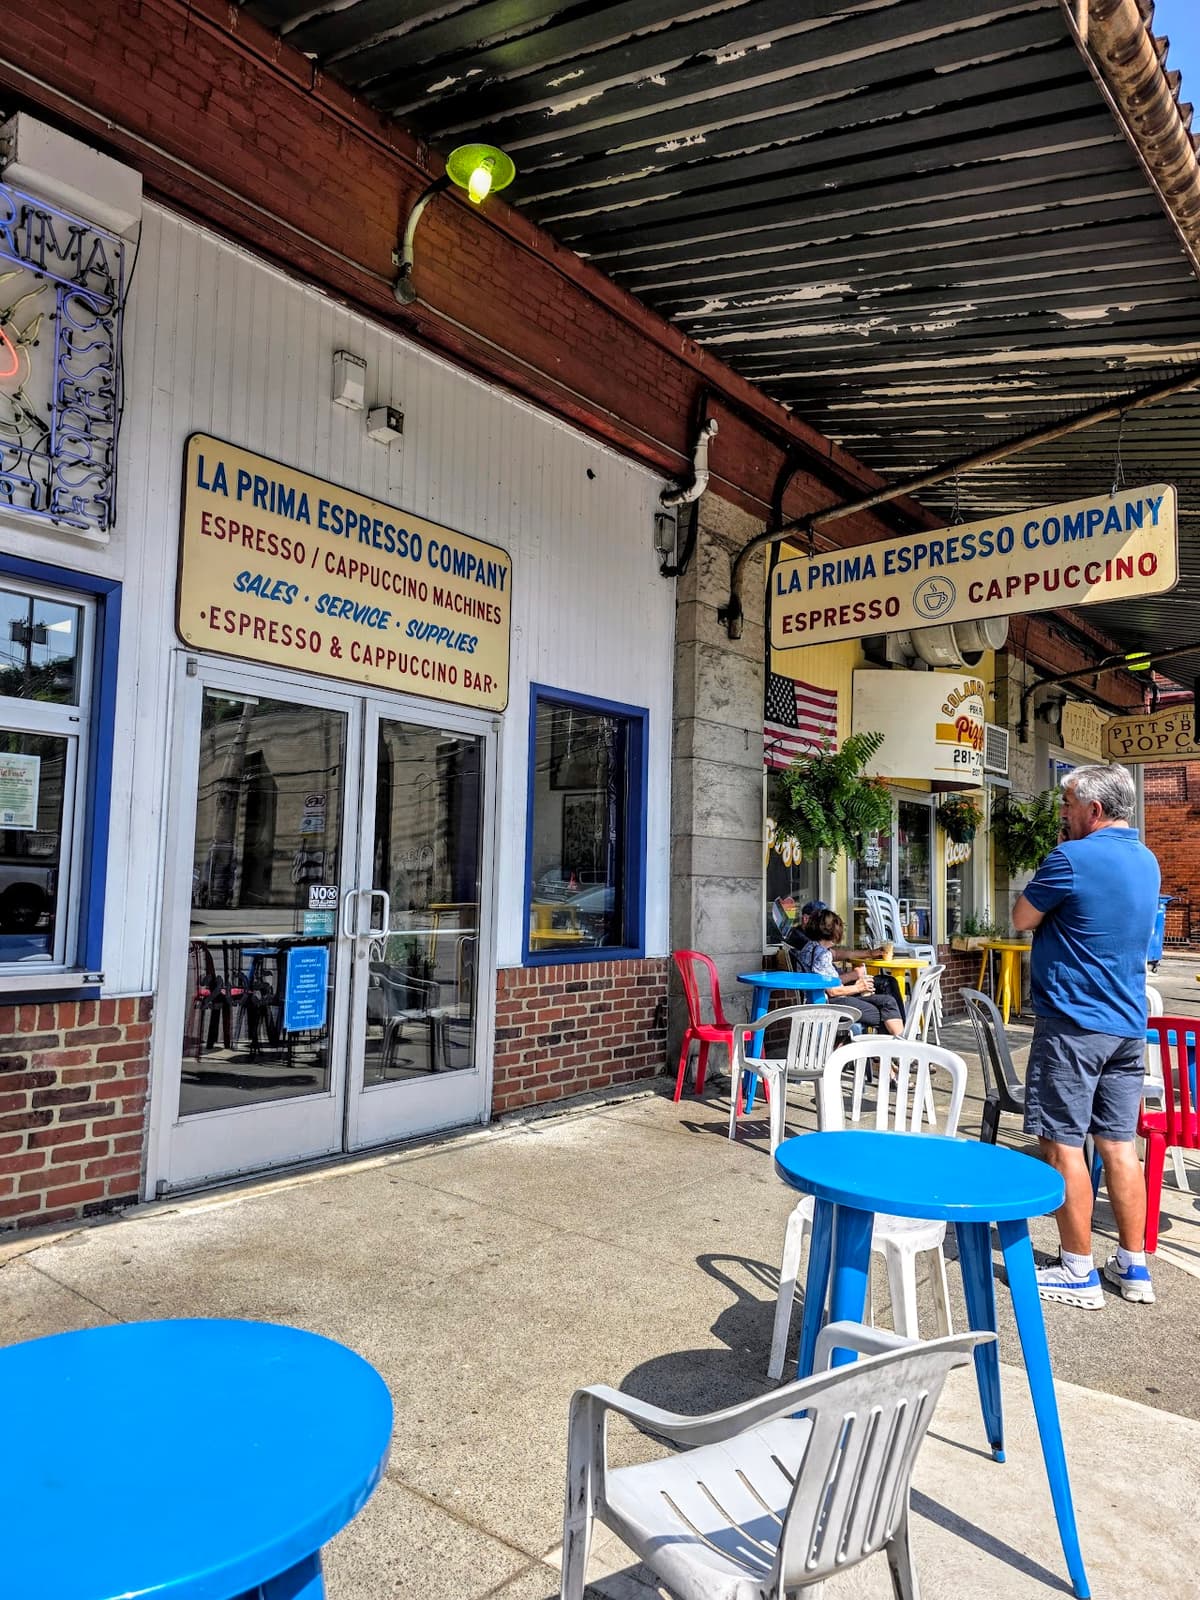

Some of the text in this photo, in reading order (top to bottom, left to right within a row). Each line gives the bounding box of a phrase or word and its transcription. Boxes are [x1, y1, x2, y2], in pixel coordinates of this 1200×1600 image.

[197, 454, 507, 591] LA PRIMA ESPRESSO COMPANY
[776, 496, 1164, 596] LA PRIMA ESPRESSO COMPANY
[200, 511, 306, 565] ESPRESSO
[324, 552, 428, 602] CAPPUCCINO
[433, 587, 502, 625] MACHINES
[781, 551, 1159, 635] ESPRESSO CAPPUCCINO
[233, 570, 479, 654] SALES SERVICE SUPPLIES
[329, 636, 343, 659] &
[350, 641, 458, 685] CAPPUCCINO
[1112, 720, 1191, 739] PITTSB
[1120, 733, 1191, 754] POPC
[311, 887, 327, 900] NO
